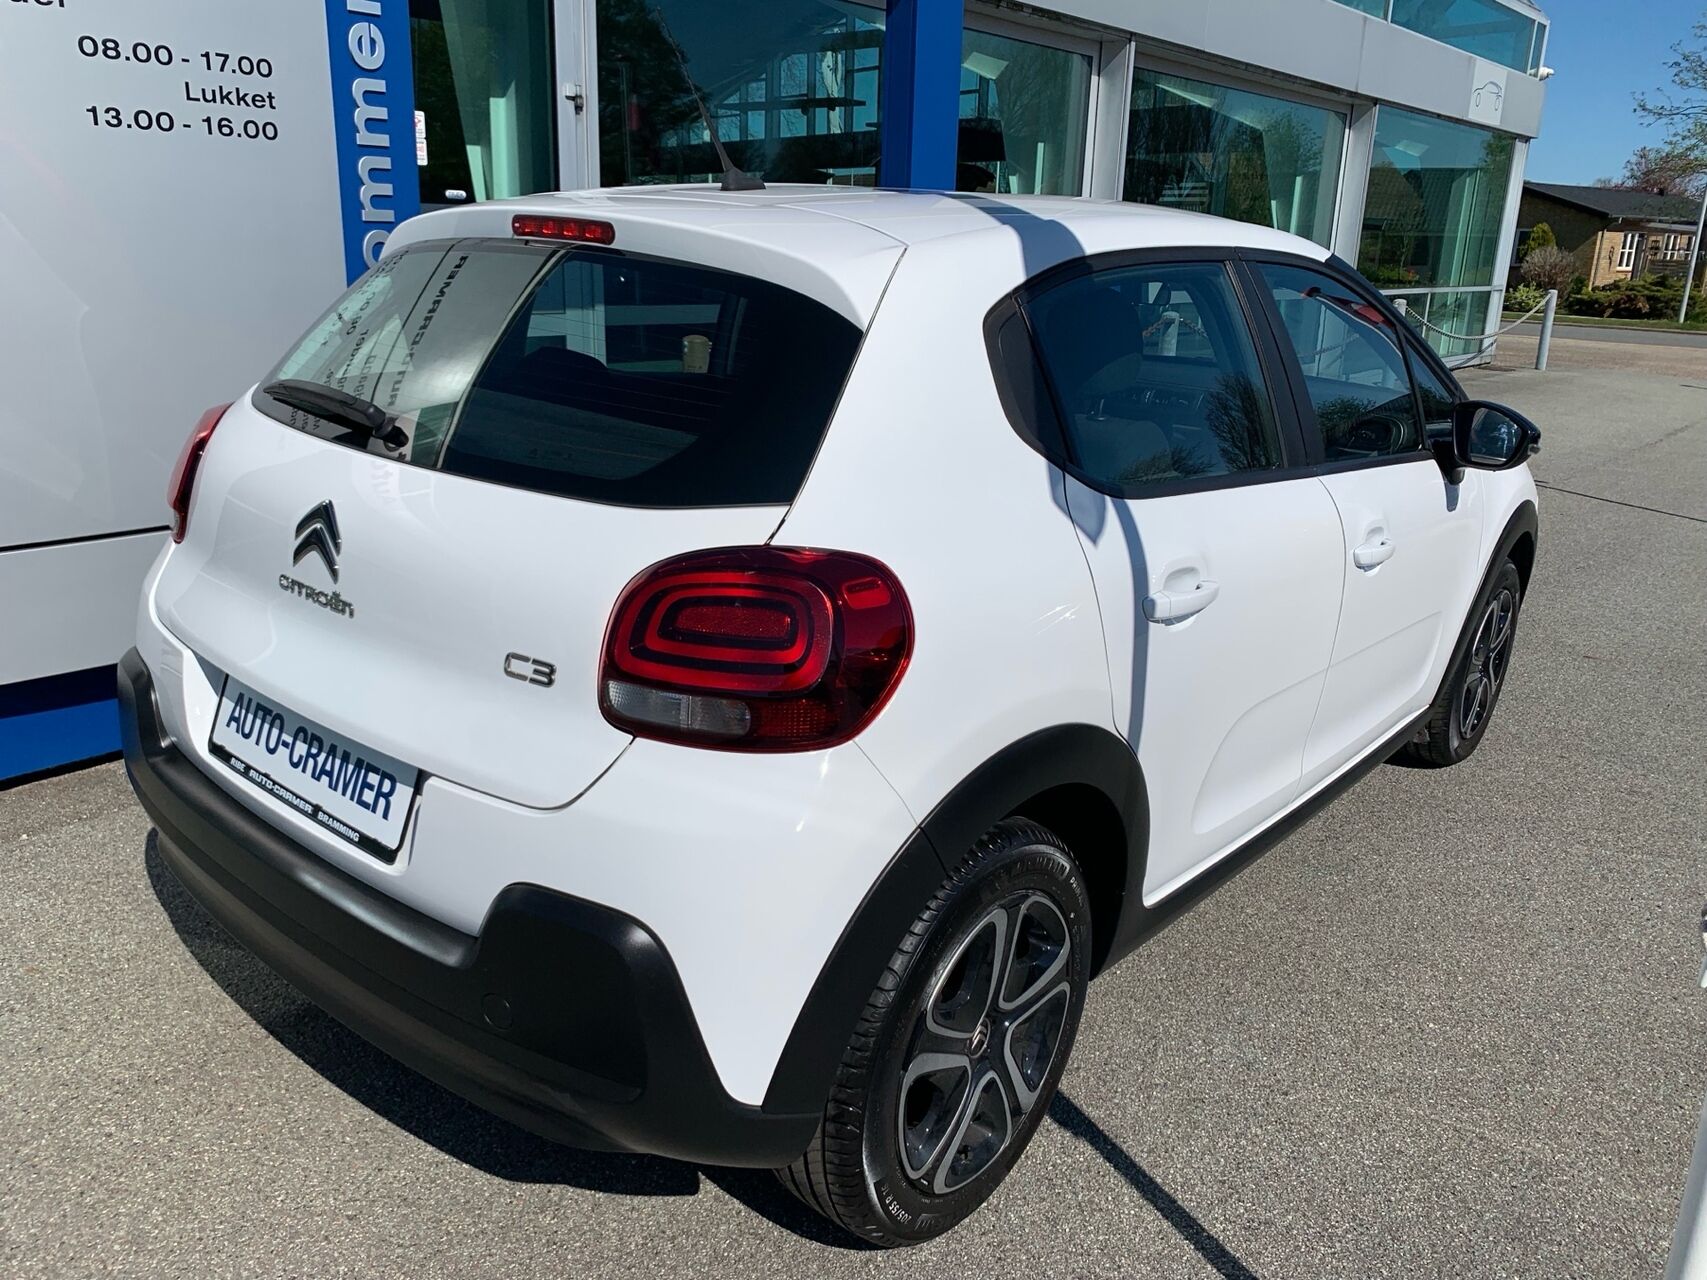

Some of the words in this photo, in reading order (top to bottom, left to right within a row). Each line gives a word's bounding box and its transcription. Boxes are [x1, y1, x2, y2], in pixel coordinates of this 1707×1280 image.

[77, 34, 174, 66] 08.00
[200, 51, 273, 78] 17.00
[184, 81, 276, 110] Lukket
[85, 106, 175, 132] 13.00
[201, 117, 279, 141] 16.00
[504, 652, 557, 688] C3
[225, 692, 398, 822] AUTO-CRAMER
[230, 757, 247, 773] RIBE
[249, 769, 314, 815] AUTO-CRAMER
[317, 811, 360, 843] BRAMMING
